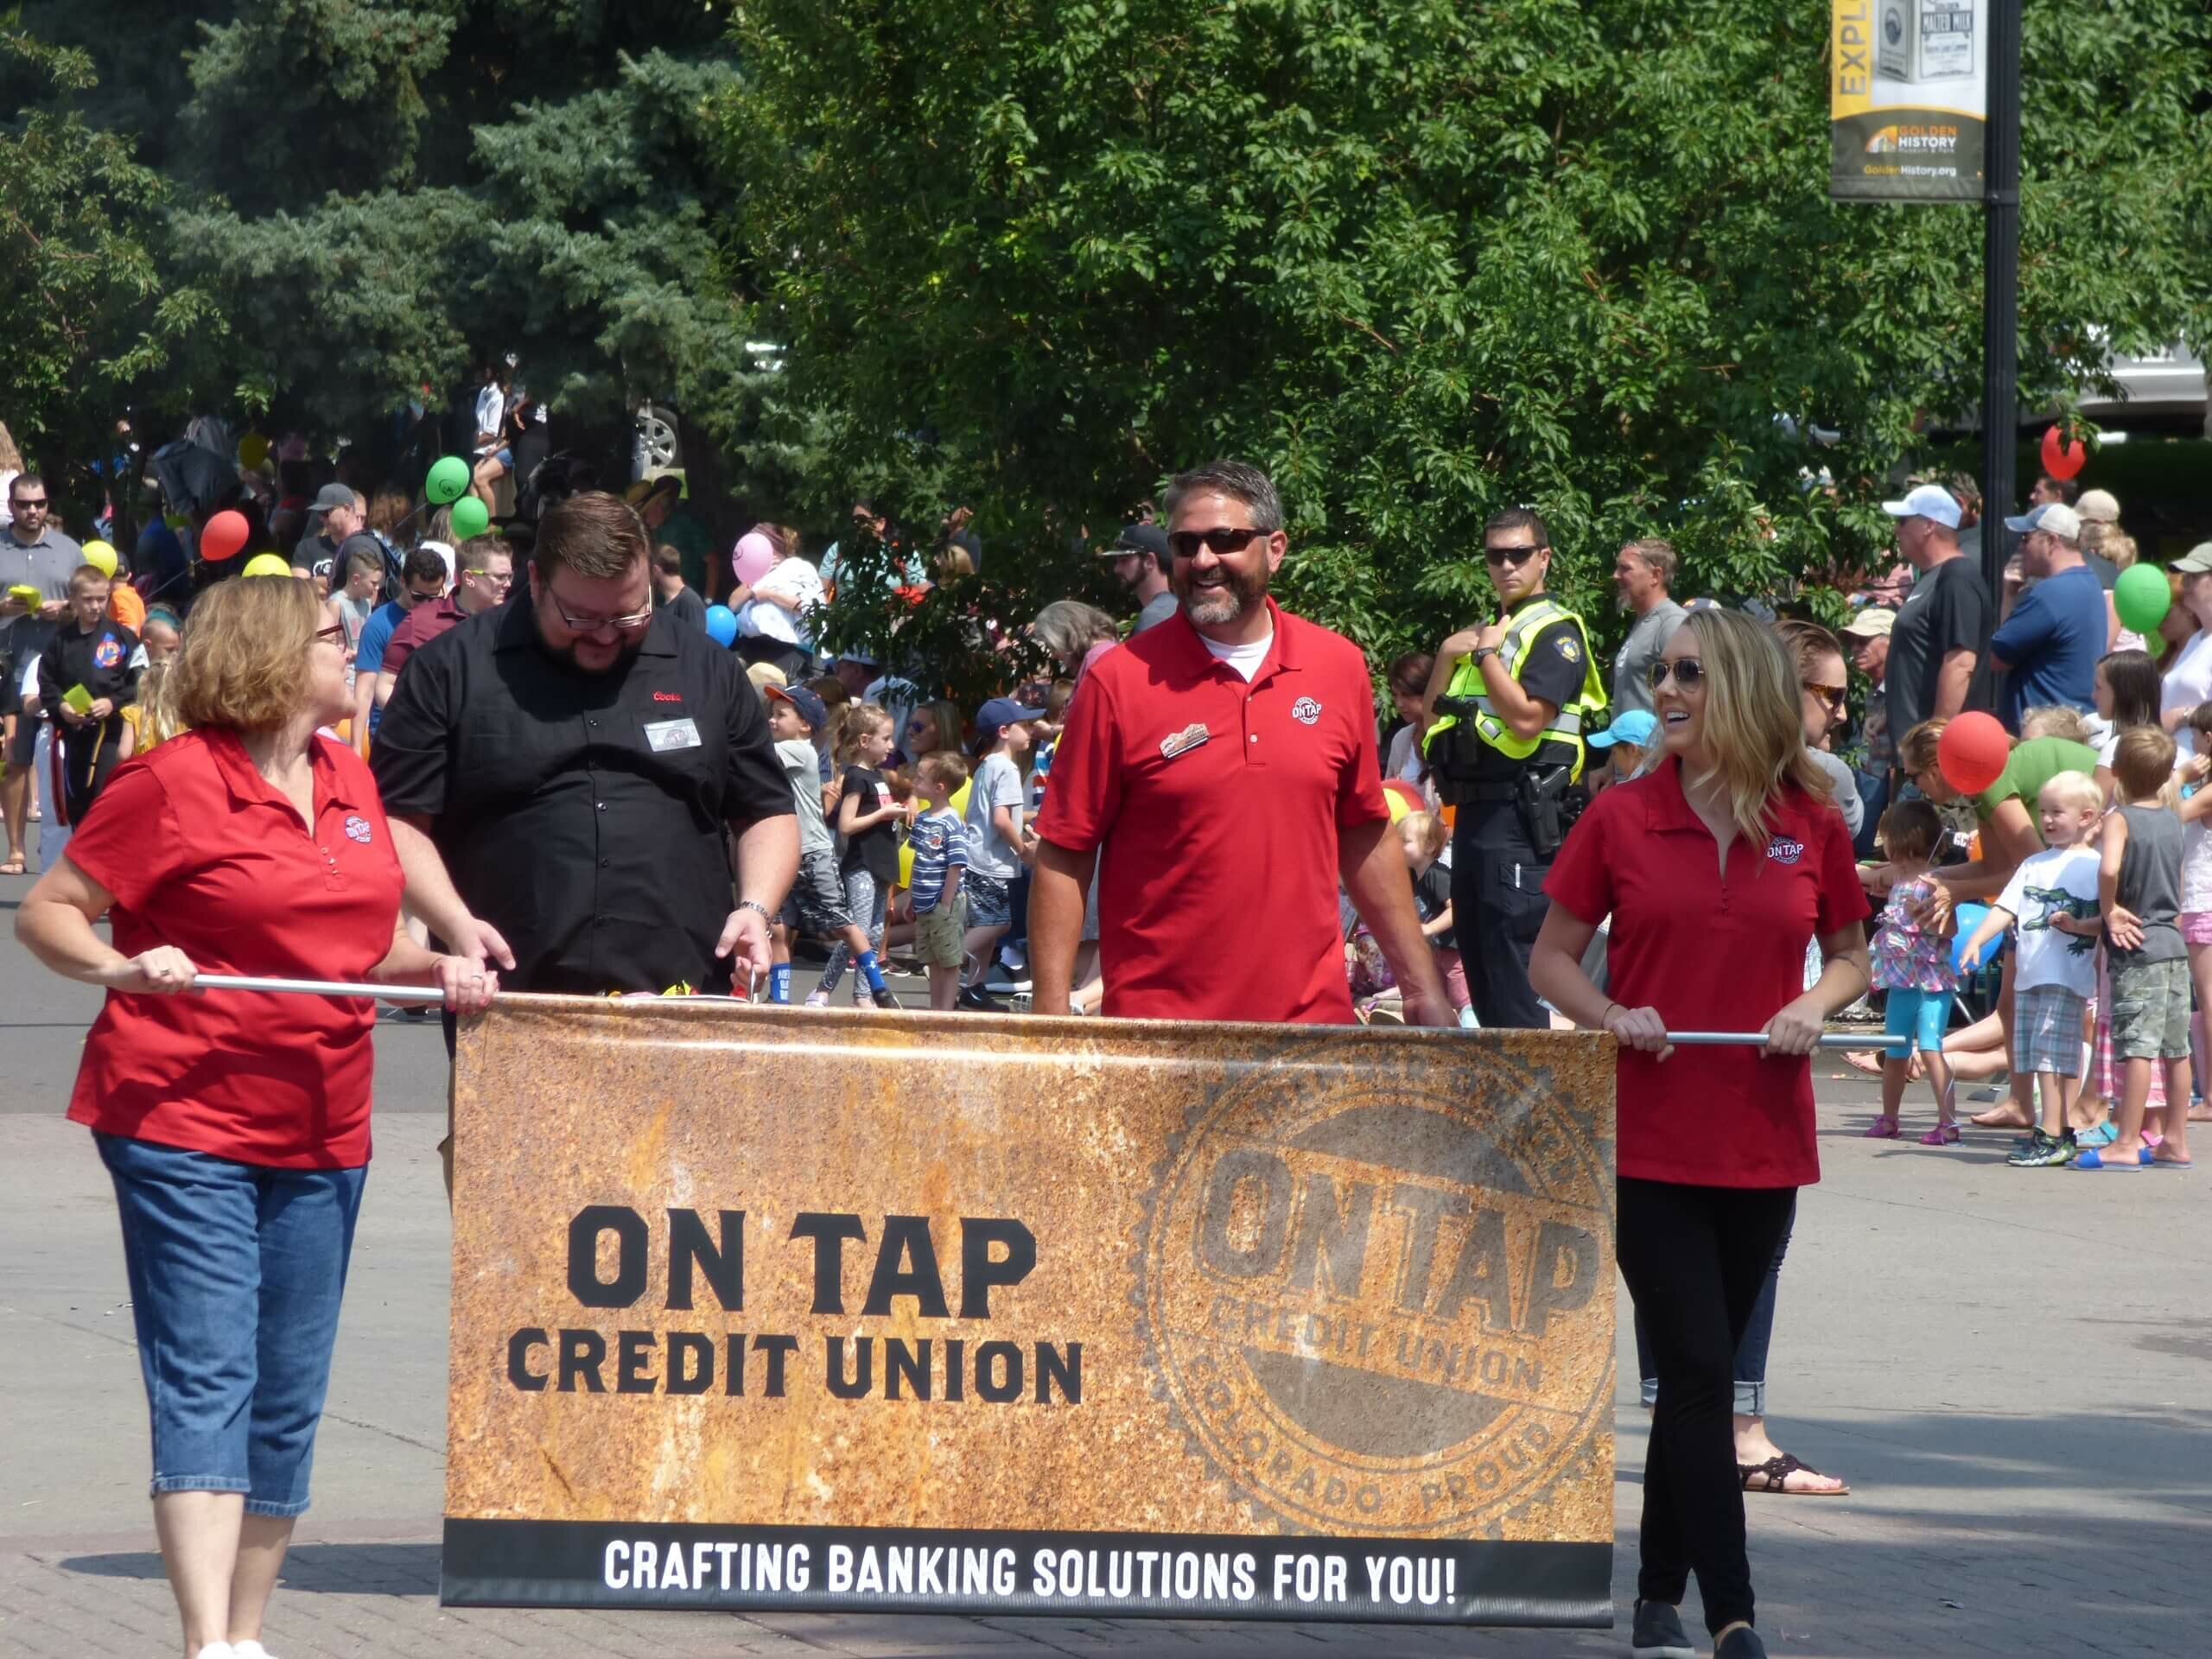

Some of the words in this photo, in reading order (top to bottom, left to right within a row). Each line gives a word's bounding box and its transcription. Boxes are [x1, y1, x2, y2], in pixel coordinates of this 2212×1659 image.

[1898, 124, 1957, 137] GOLDEN
[1898, 136, 1957, 148] HISTORY
[1864, 165, 1957, 177] GoldenHistory.org
[567, 1205, 747, 1313] ON
[787, 1211, 1037, 1320] TAP
[506, 1327, 800, 1399] CREDIT
[825, 1335, 1083, 1404] UNION
[1210, 1293, 1375, 1358] CREDIT
[1396, 1332, 1543, 1392] UNION
[1189, 1353, 1382, 1514] COLORADO
[1419, 1422, 1551, 1512] PROUD
[604, 1539, 810, 1593] CRAFTING
[828, 1544, 1016, 1598] BANKING
[1032, 1548, 1257, 1602] SOLUTIONS
[1274, 1554, 1347, 1603] FOR
[1365, 1556, 1456, 1605] YOU!
